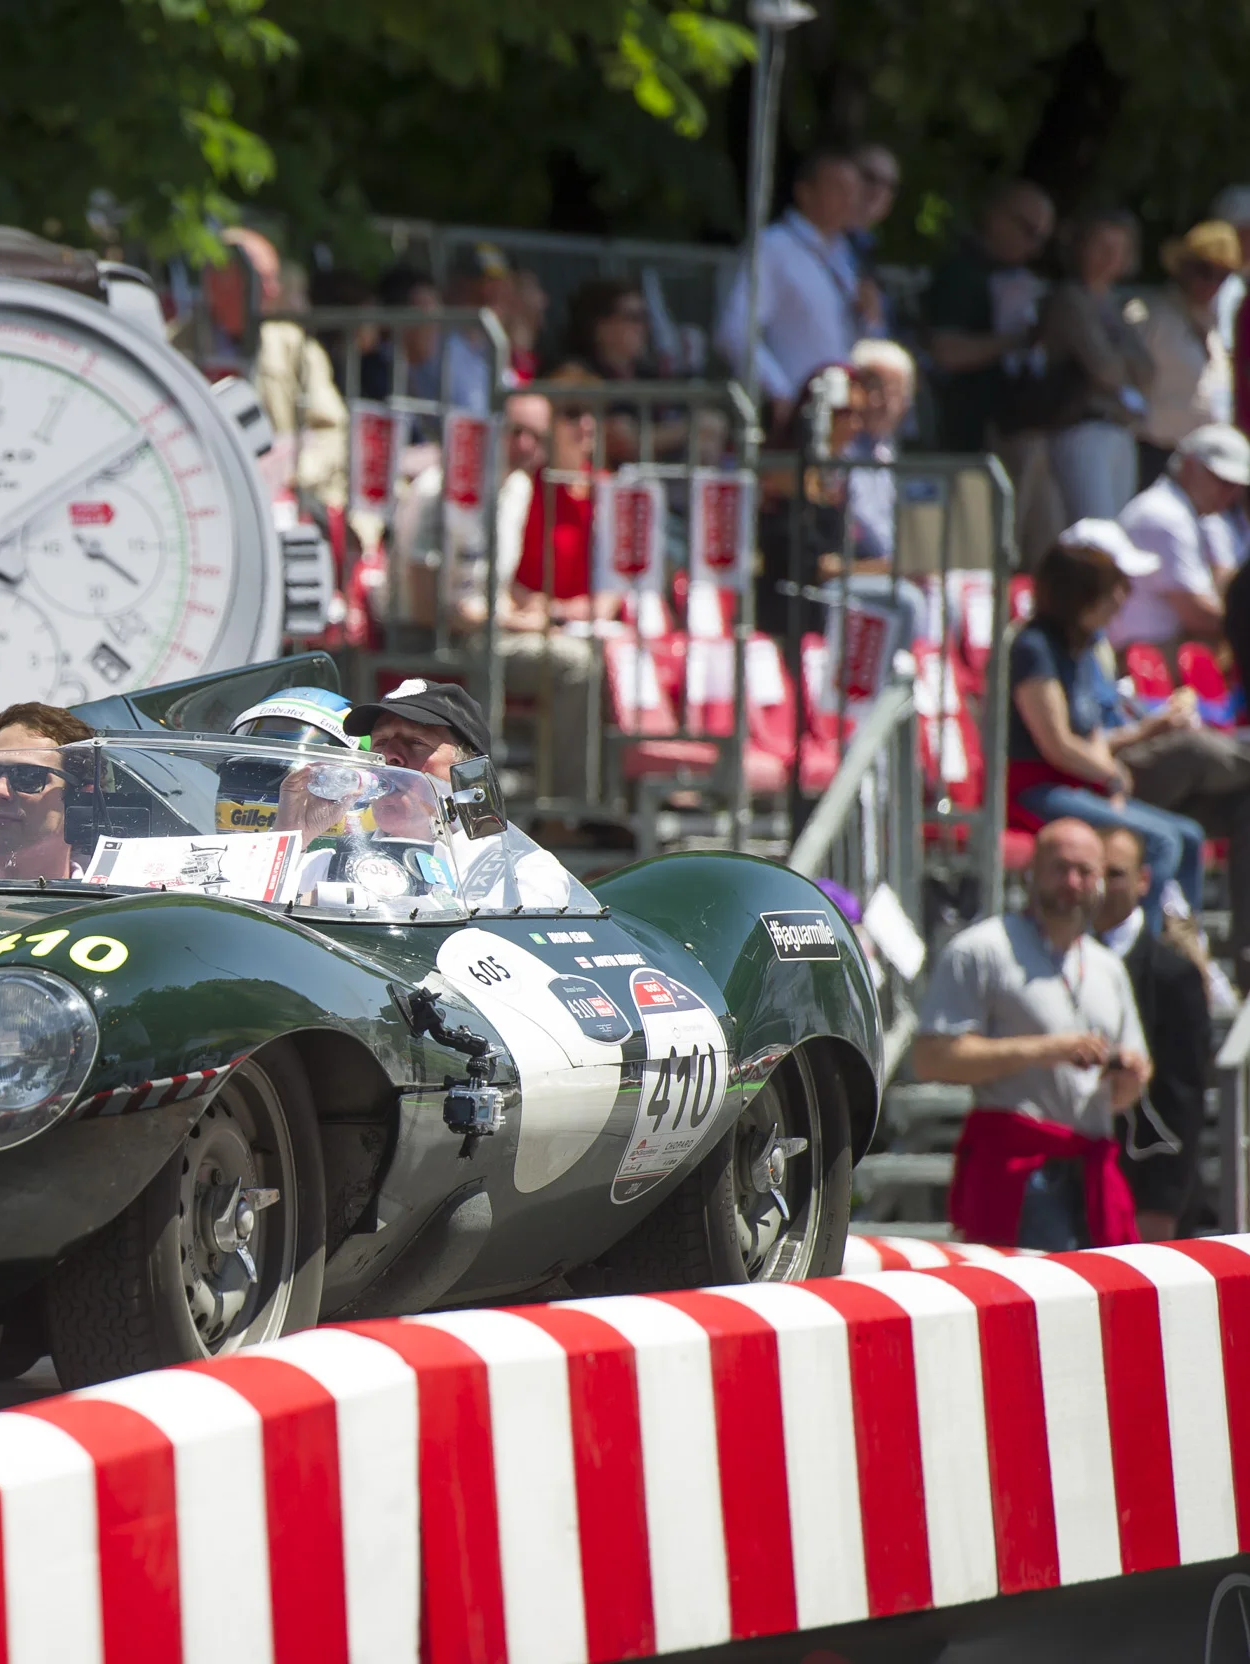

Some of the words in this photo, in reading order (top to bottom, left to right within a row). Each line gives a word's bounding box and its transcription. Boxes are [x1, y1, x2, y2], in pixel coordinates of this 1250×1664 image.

[31, 396, 69, 446] 1
[259, 706, 305, 719] Embratel
[319, 717, 357, 748] Embratel
[468, 955, 512, 987] 605
[565, 998, 597, 1019] 410
[646, 1042, 718, 1134] 410
